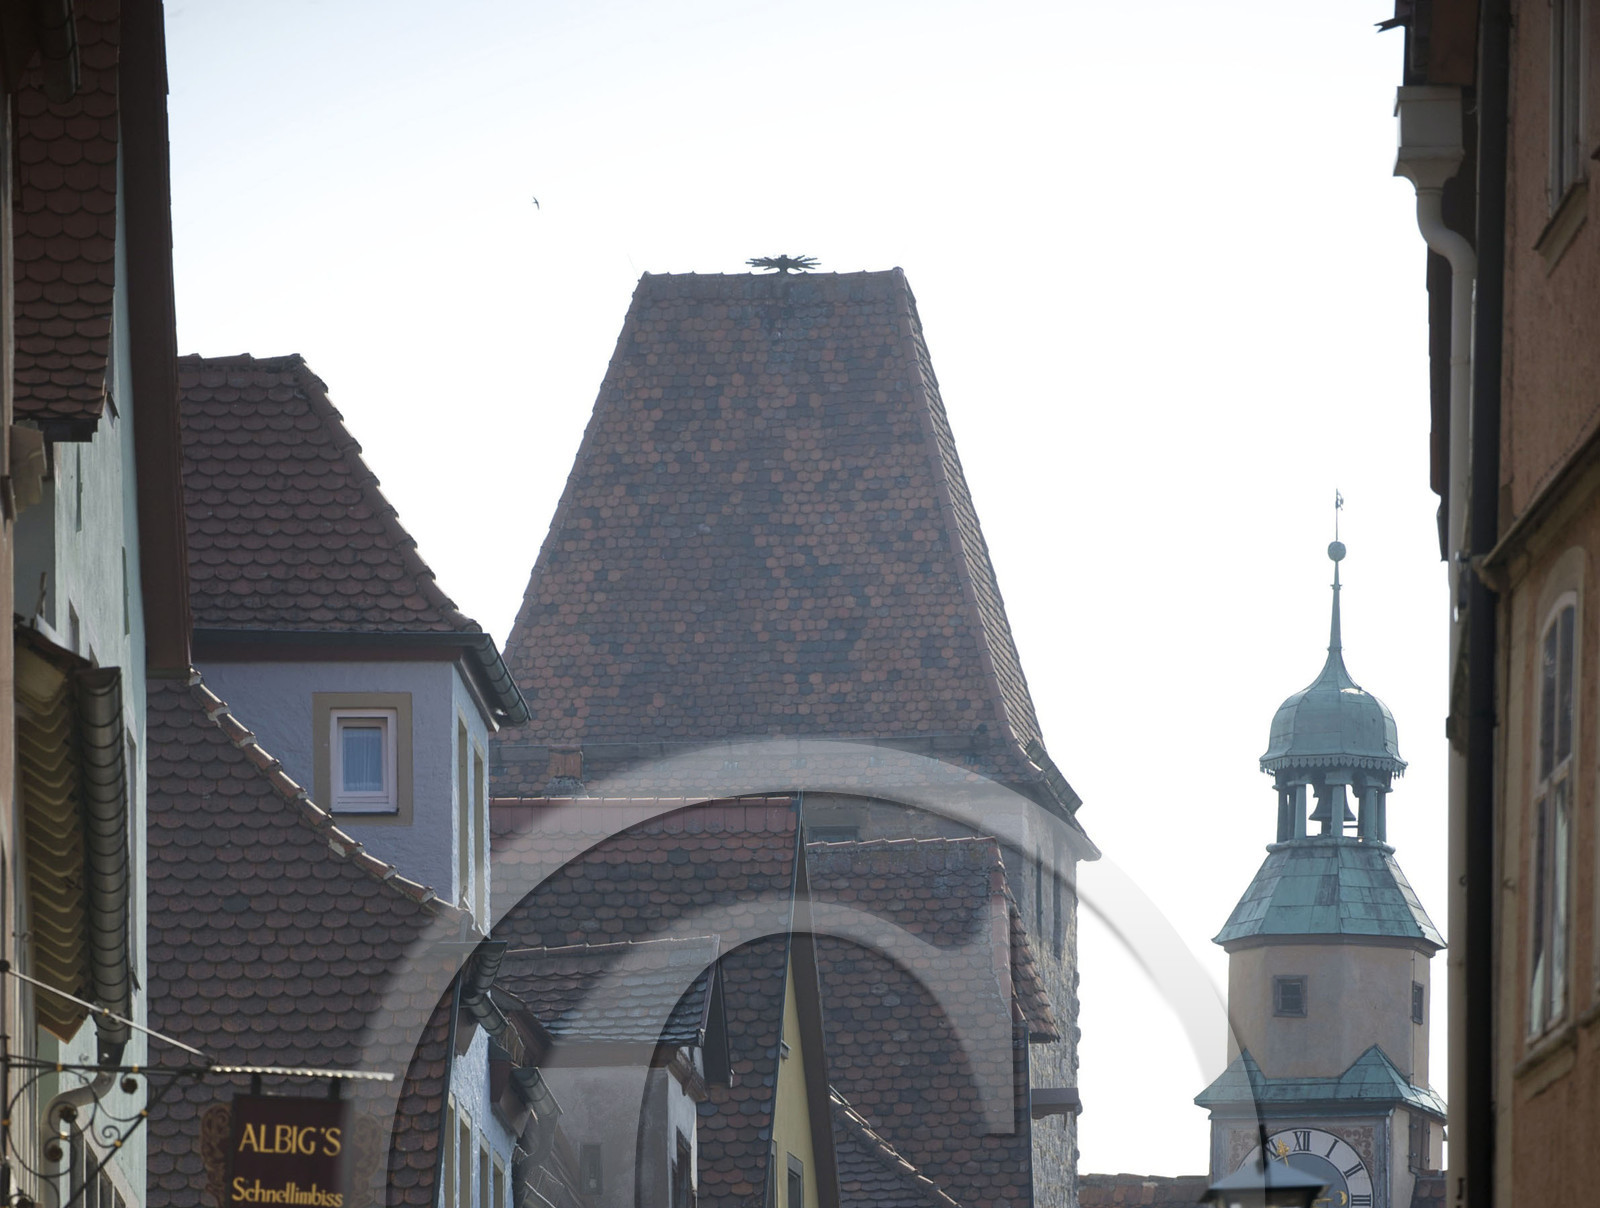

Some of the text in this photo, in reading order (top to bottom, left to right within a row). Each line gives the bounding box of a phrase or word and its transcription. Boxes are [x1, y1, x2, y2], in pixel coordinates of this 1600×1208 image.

[238, 1122, 342, 1157] ALBIG'S
[1292, 1130, 1312, 1153] XII
[231, 1176, 344, 1208] Schnellimbiss
[1351, 1193, 1372, 1208] III
